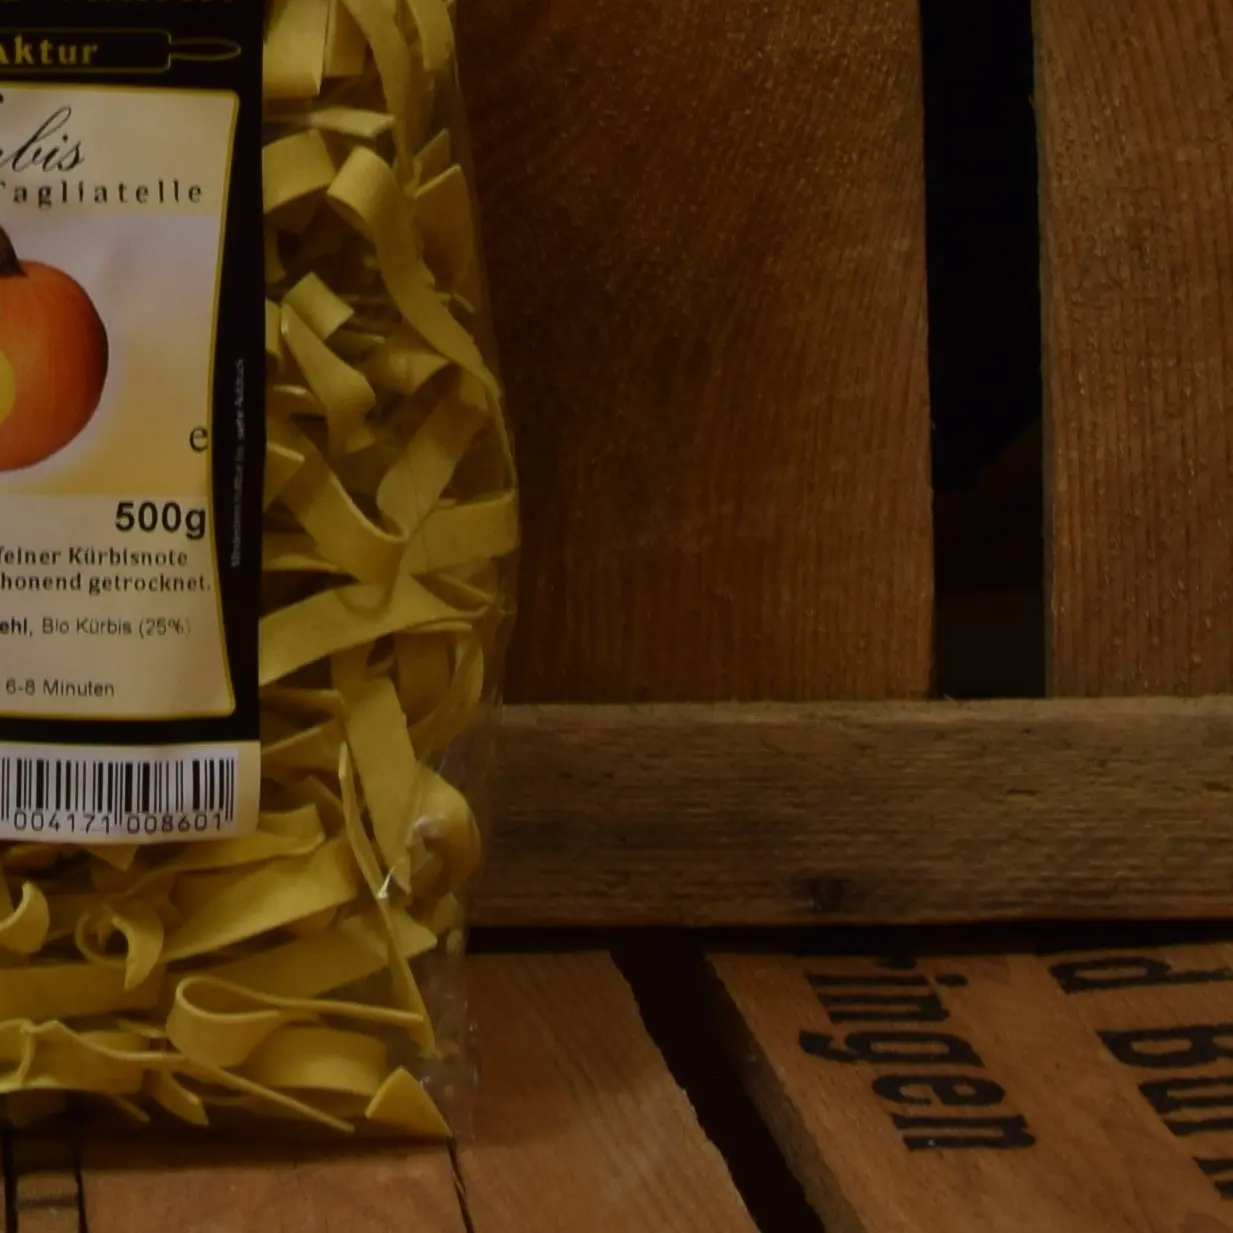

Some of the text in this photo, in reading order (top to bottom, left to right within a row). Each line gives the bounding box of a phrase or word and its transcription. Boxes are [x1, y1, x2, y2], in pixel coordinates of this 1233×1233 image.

[115, 501, 206, 540] 500g
[69, 546, 188, 566] Kürbisnote
[89, 573, 211, 595] getrocknet.
[42, 617, 69, 634] Bio
[76, 617, 132, 635] Kürbis
[138, 617, 192, 639] (25%)
[6, 678, 35, 696] 6-8
[43, 679, 115, 697] Minuten
[14, 811, 110, 833] 004171
[126, 813, 221, 834] 008601
